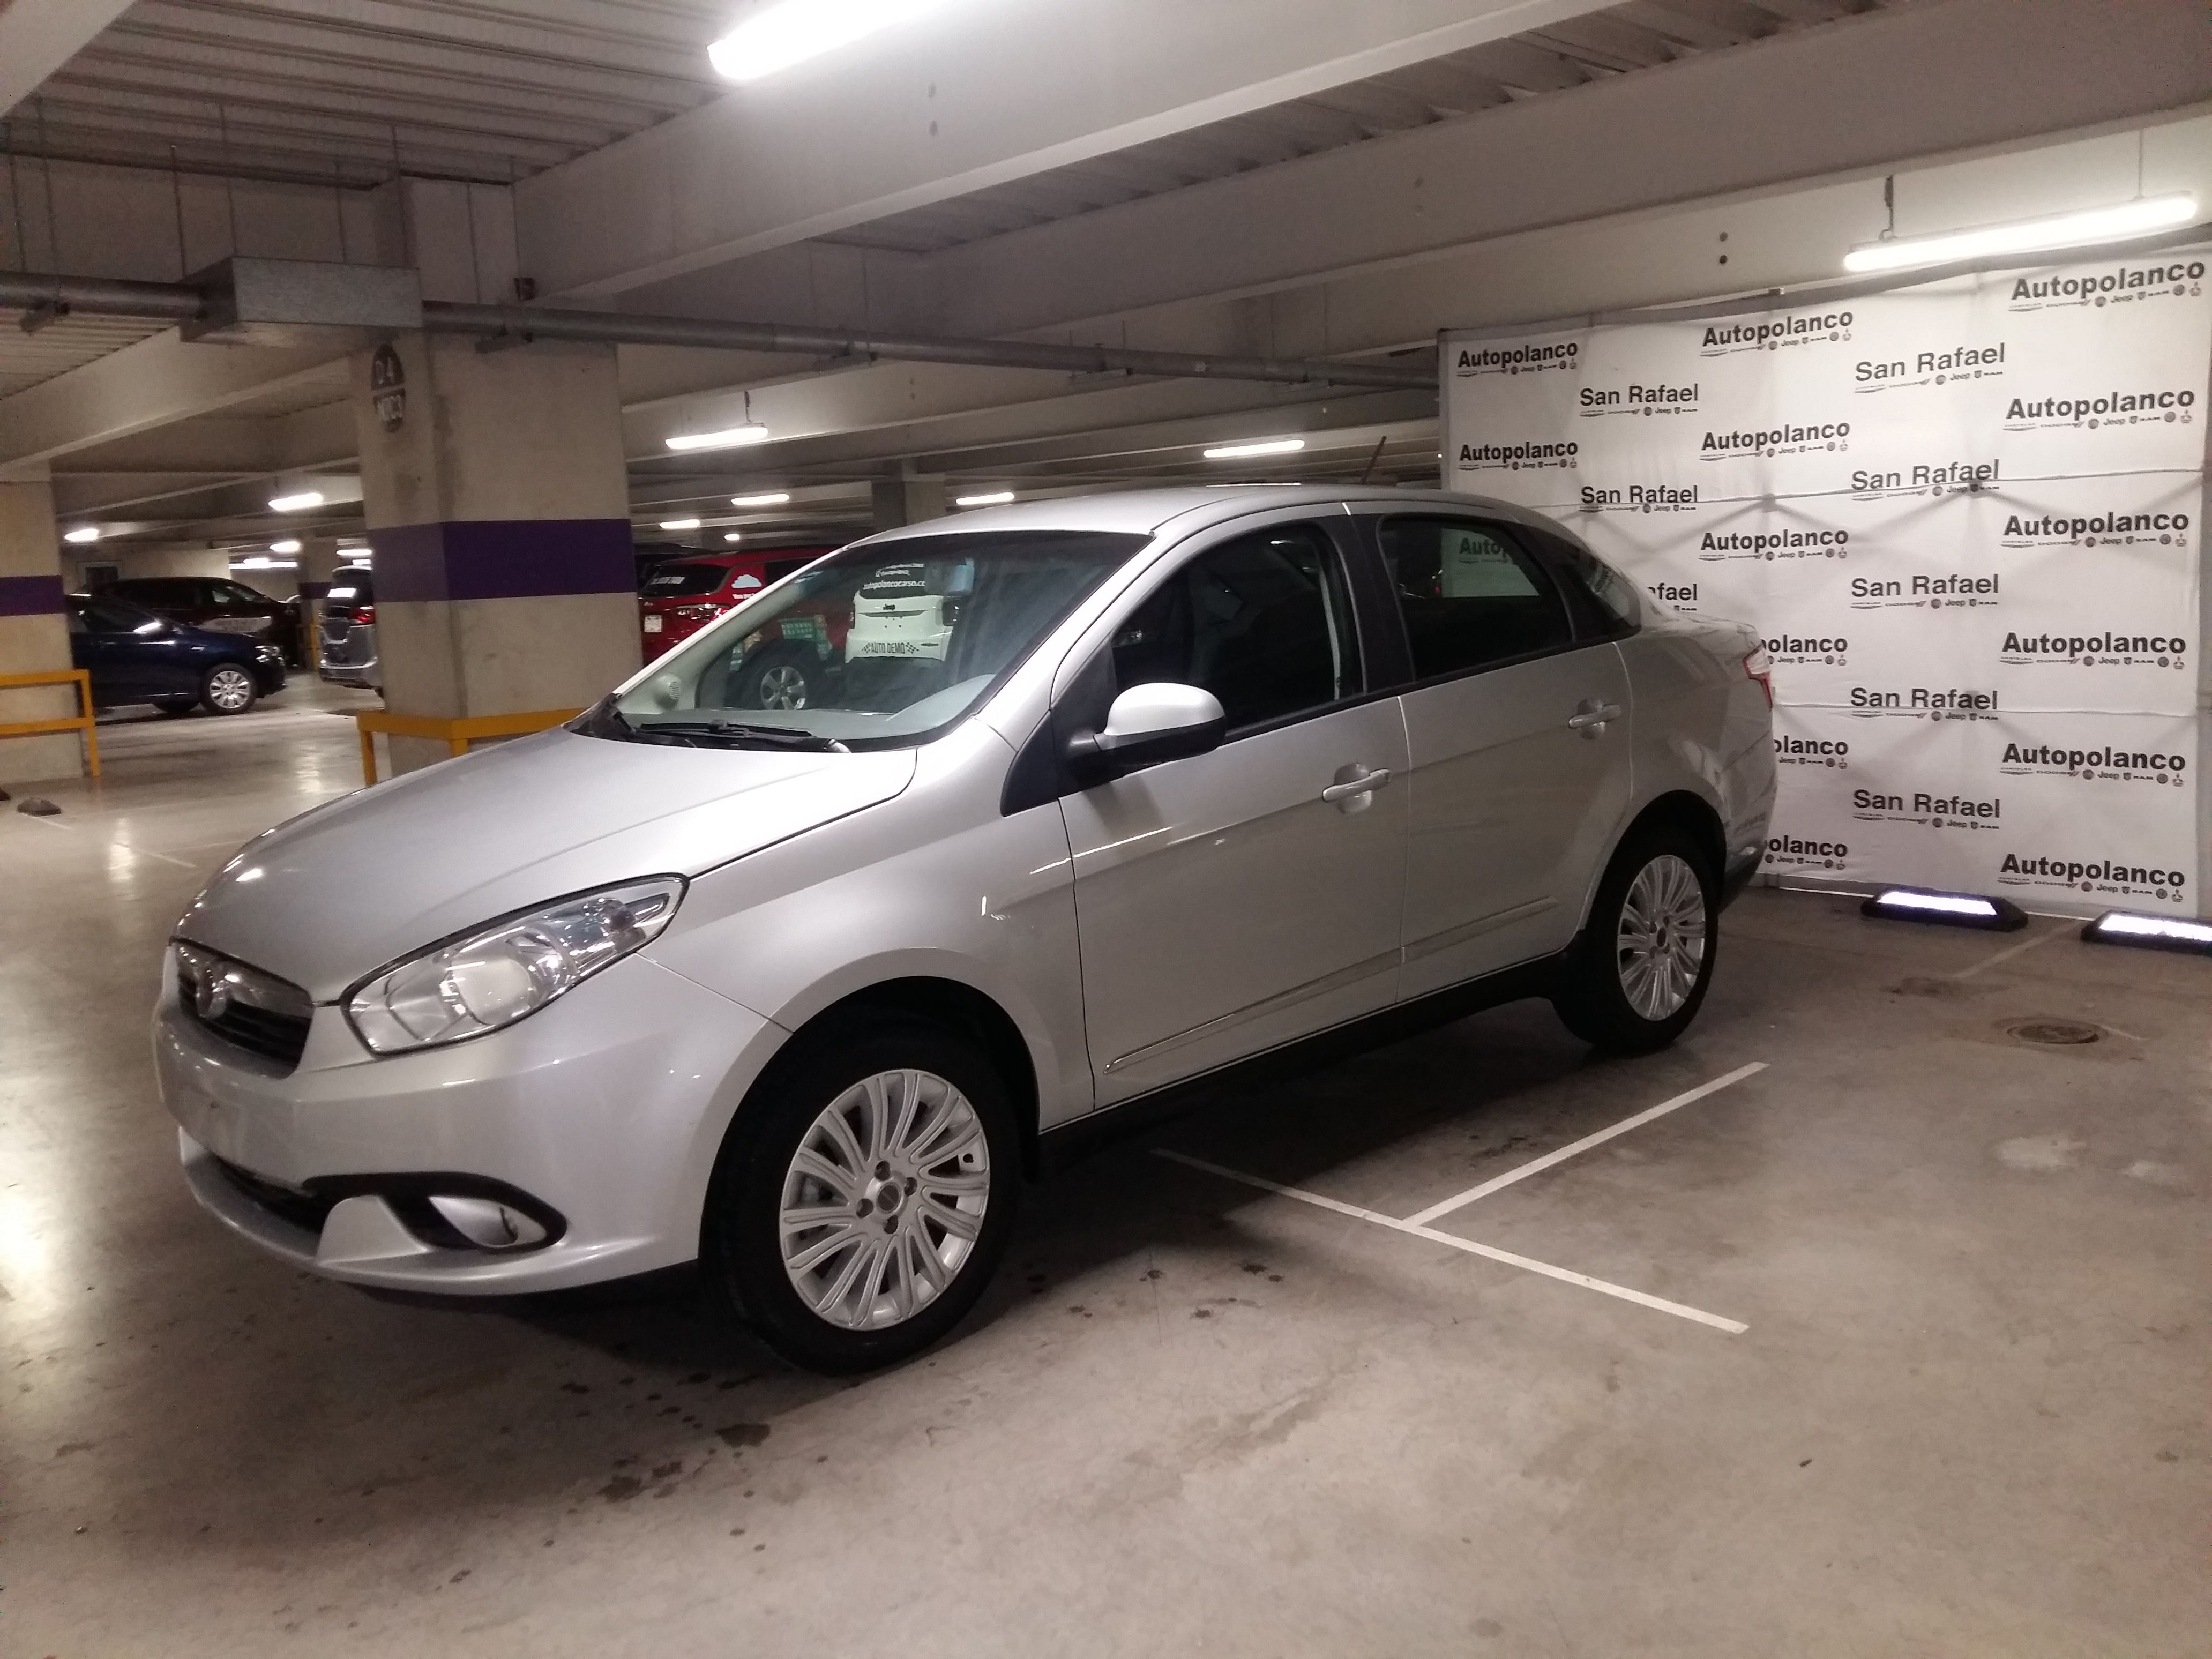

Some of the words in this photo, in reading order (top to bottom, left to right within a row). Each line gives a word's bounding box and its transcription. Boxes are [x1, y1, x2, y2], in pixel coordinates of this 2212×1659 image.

[2011, 261, 2204, 300] Autopolanco
[1702, 311, 1853, 347] Autopolanco
[1458, 343, 1578, 368] Autopolanco
[1855, 361, 1905, 382] San
[1917, 342, 2005, 373] Rafael
[1580, 388, 1620, 406] San
[1628, 383, 1698, 402] Rafael
[2006, 390, 2195, 421] Autopolanco
[1701, 422, 1850, 451] Autopolanco
[1459, 442, 1578, 463] Autopolanco
[1851, 470, 1901, 490] San
[1912, 459, 1999, 484] Rafael
[1581, 485, 1620, 504] San
[1629, 485, 1698, 503] Rafael
[2002, 511, 2189, 539] Autopolanco
[1459, 537, 1507, 558] Auto
[1700, 529, 1848, 553] Autopolanco
[1851, 578, 1901, 597] San
[1912, 573, 1999, 595] Rafael
[871, 642, 885, 653] AUTO
[886, 642, 906, 654] DEMO
[2001, 631, 2186, 657] Autopolanco
[2098, 656, 2120, 665] Jeep
[1851, 687, 1900, 707] San
[1911, 688, 1997, 710] Rafael
[2002, 743, 2186, 771] Autopolanco
[2097, 771, 2120, 780] Jeep
[1854, 789, 1903, 810] San
[1914, 793, 2000, 818] Rafael
[1766, 835, 1848, 857] olanco
[2000, 853, 2185, 887] Autopolanco
[2097, 884, 2119, 893] Jeep
